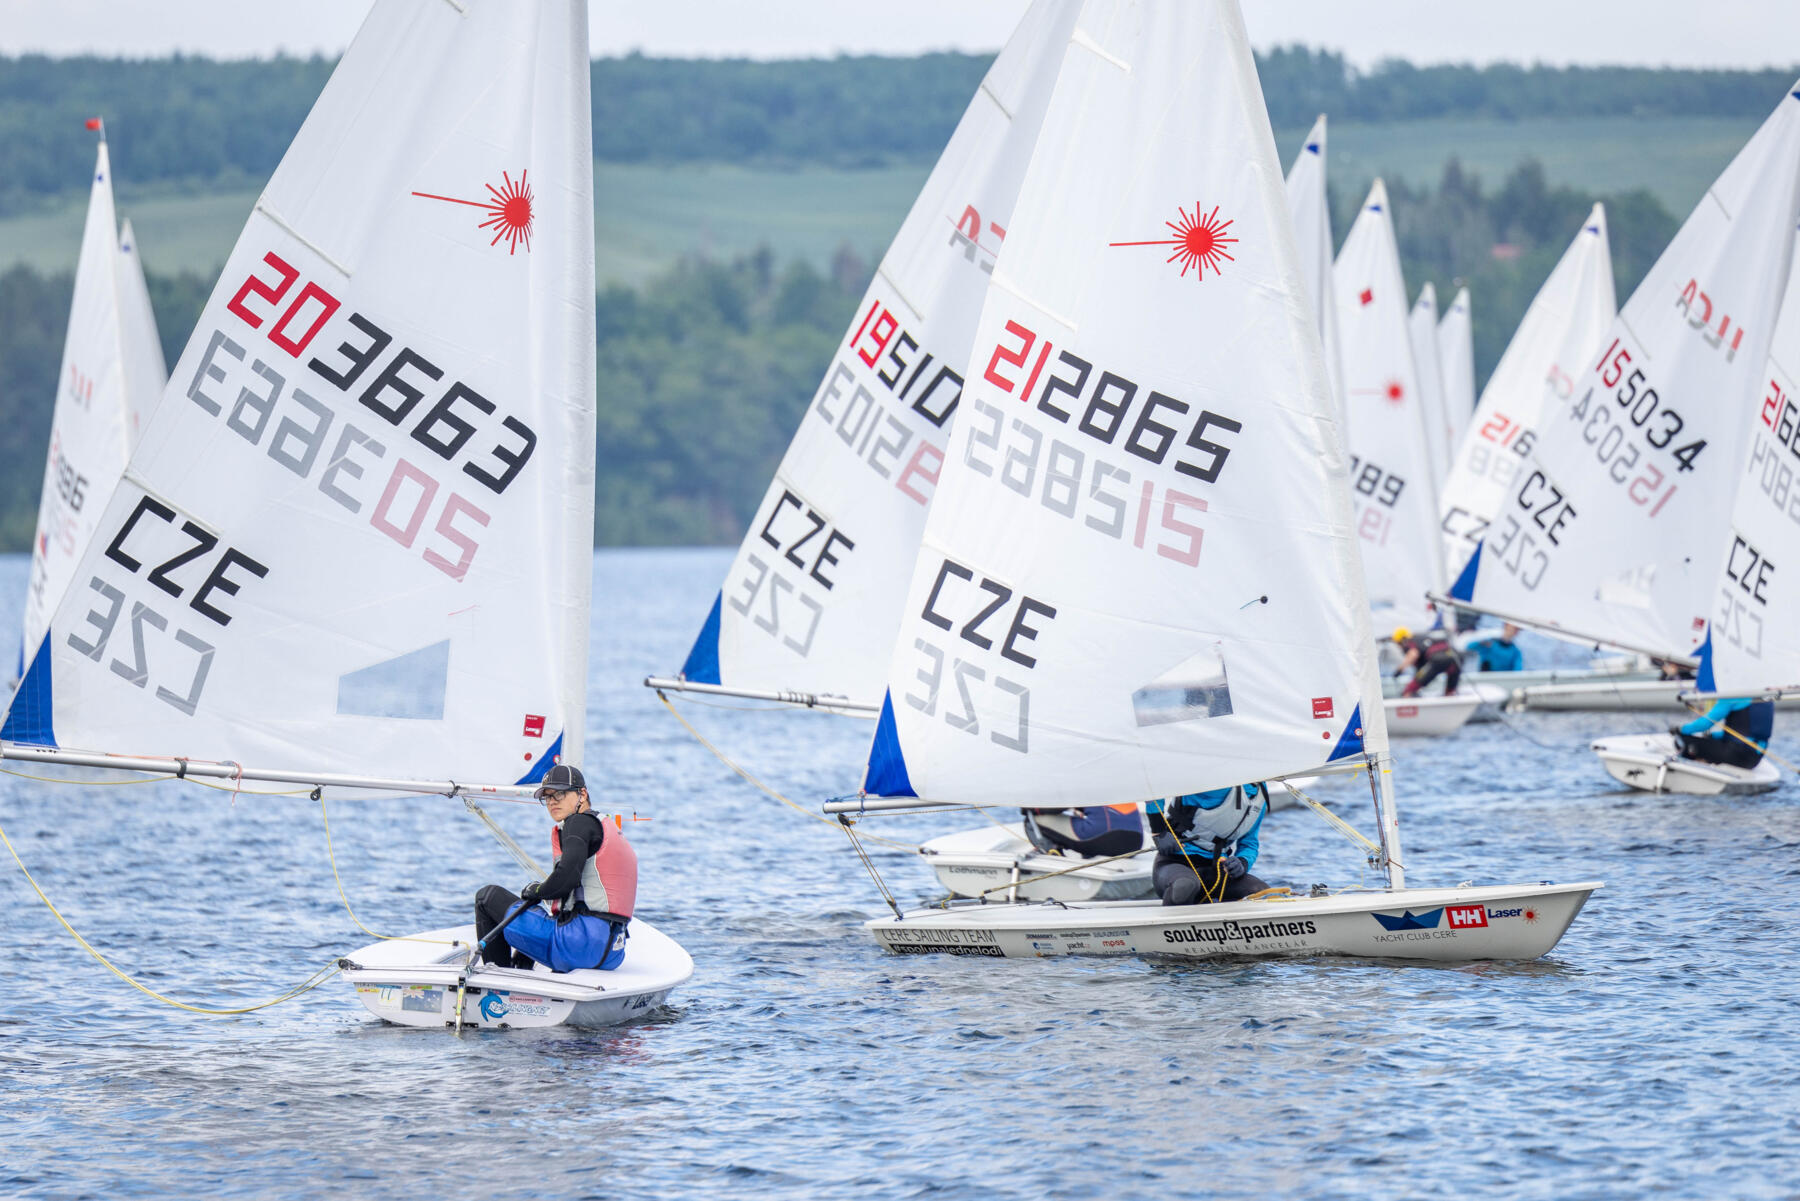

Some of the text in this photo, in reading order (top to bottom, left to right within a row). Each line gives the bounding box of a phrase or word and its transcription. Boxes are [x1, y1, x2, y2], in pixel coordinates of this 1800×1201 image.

[227, 251, 538, 494] 203663
[850, 299, 965, 428] 19510
[983, 319, 1243, 484] 212865
[1596, 338, 1708, 472] 155034
[761, 489, 855, 591] CZE
[1441, 506, 1492, 545] CZ
[1518, 471, 1577, 546] CZE
[105, 495, 269, 626] CZE
[1726, 535, 1775, 606] CZE
[921, 559, 1058, 670] CZE
[881, 929, 997, 943] CERE SAILING TEAM
[1163, 920, 1317, 945] soukup&partners
[1373, 930, 1457, 943] YACHT CLUB CERE
[1451, 910, 1483, 926] HH
[1487, 907, 1523, 919] Laser
